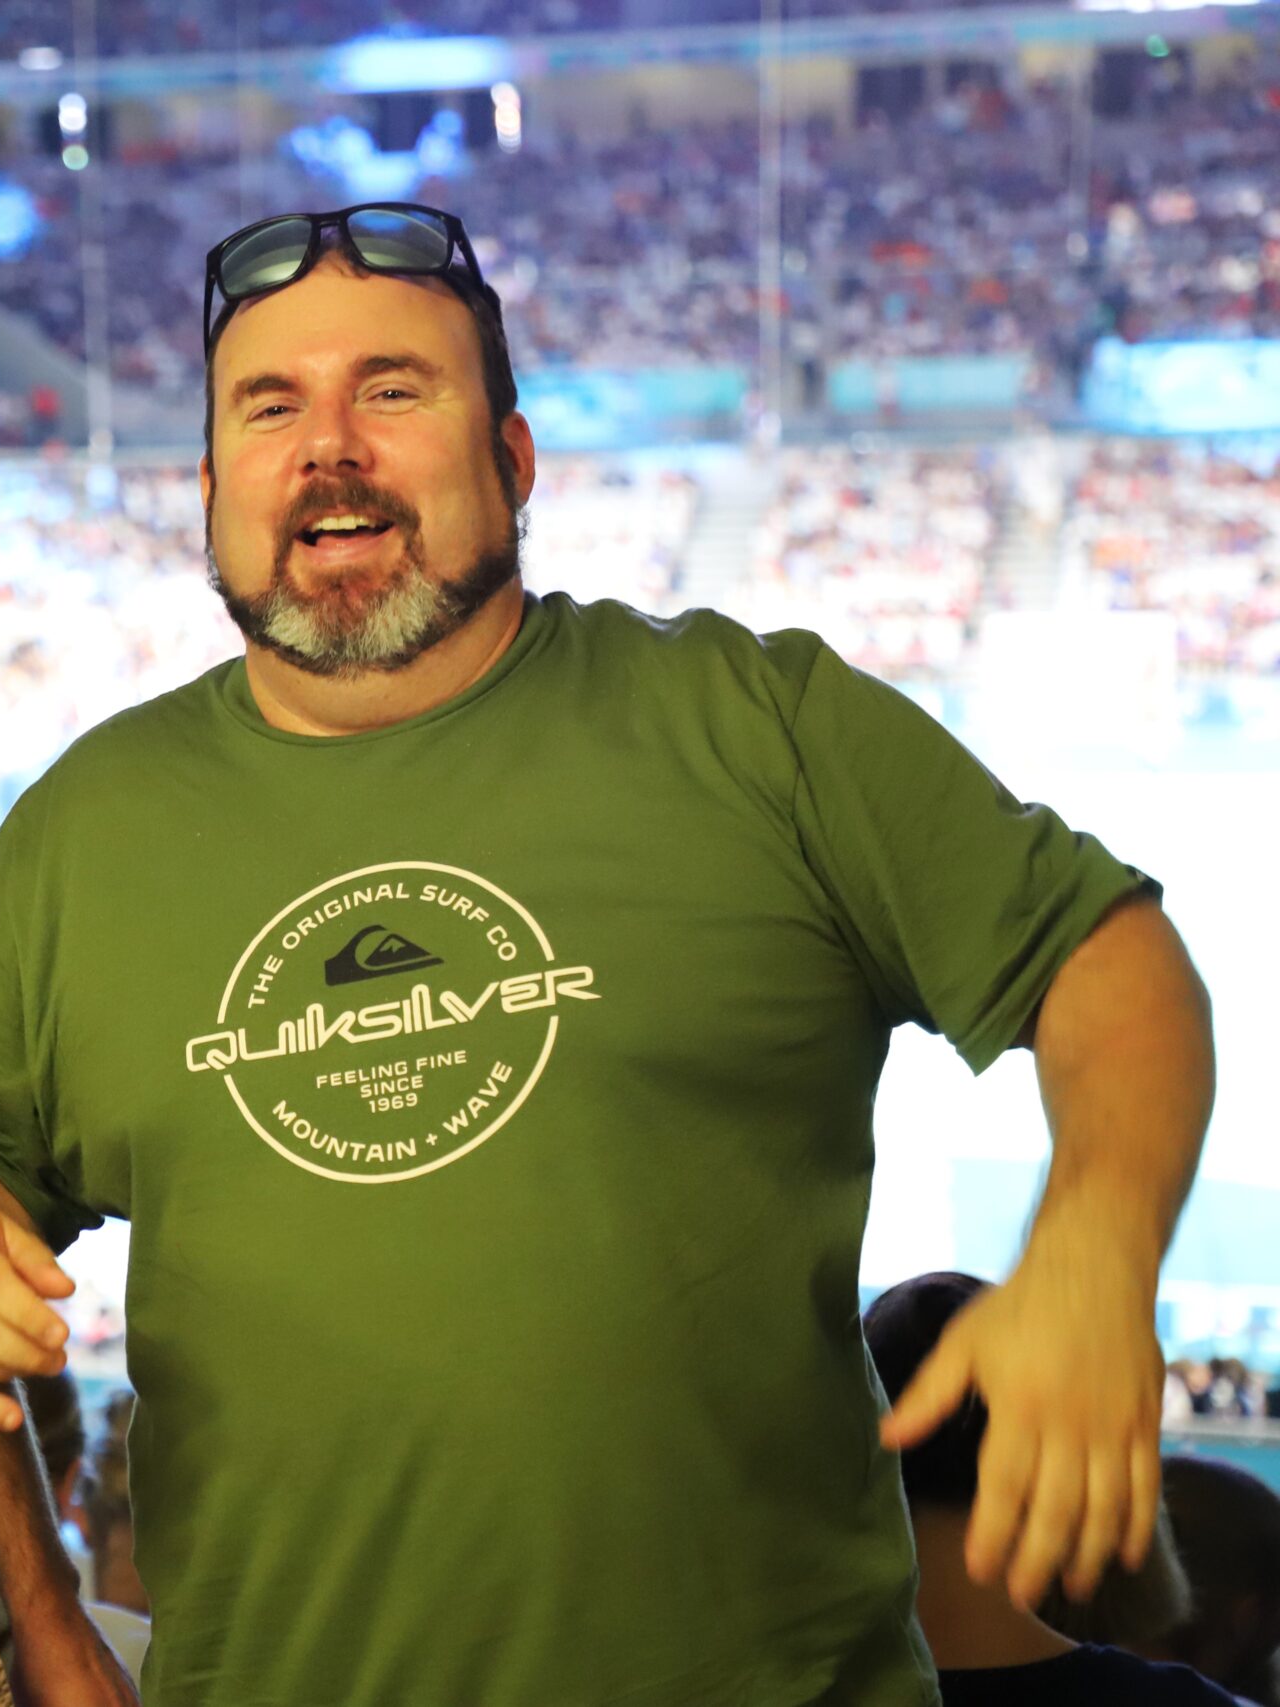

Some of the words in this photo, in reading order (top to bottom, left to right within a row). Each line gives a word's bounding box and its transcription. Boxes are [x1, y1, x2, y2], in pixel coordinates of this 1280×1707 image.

[247, 954, 284, 1009] THE
[281, 882, 410, 950] ORIGINAL
[419, 884, 490, 922] SURF
[486, 924, 518, 962] CO
[316, 1060, 408, 1089] FEELING
[415, 1049, 467, 1072] FINE
[359, 1074, 424, 1099] SINCE
[272, 1097, 417, 1163] MOUNTAIN
[442, 1060, 513, 1136] WAVE
[368, 1092, 418, 1114] 1969
